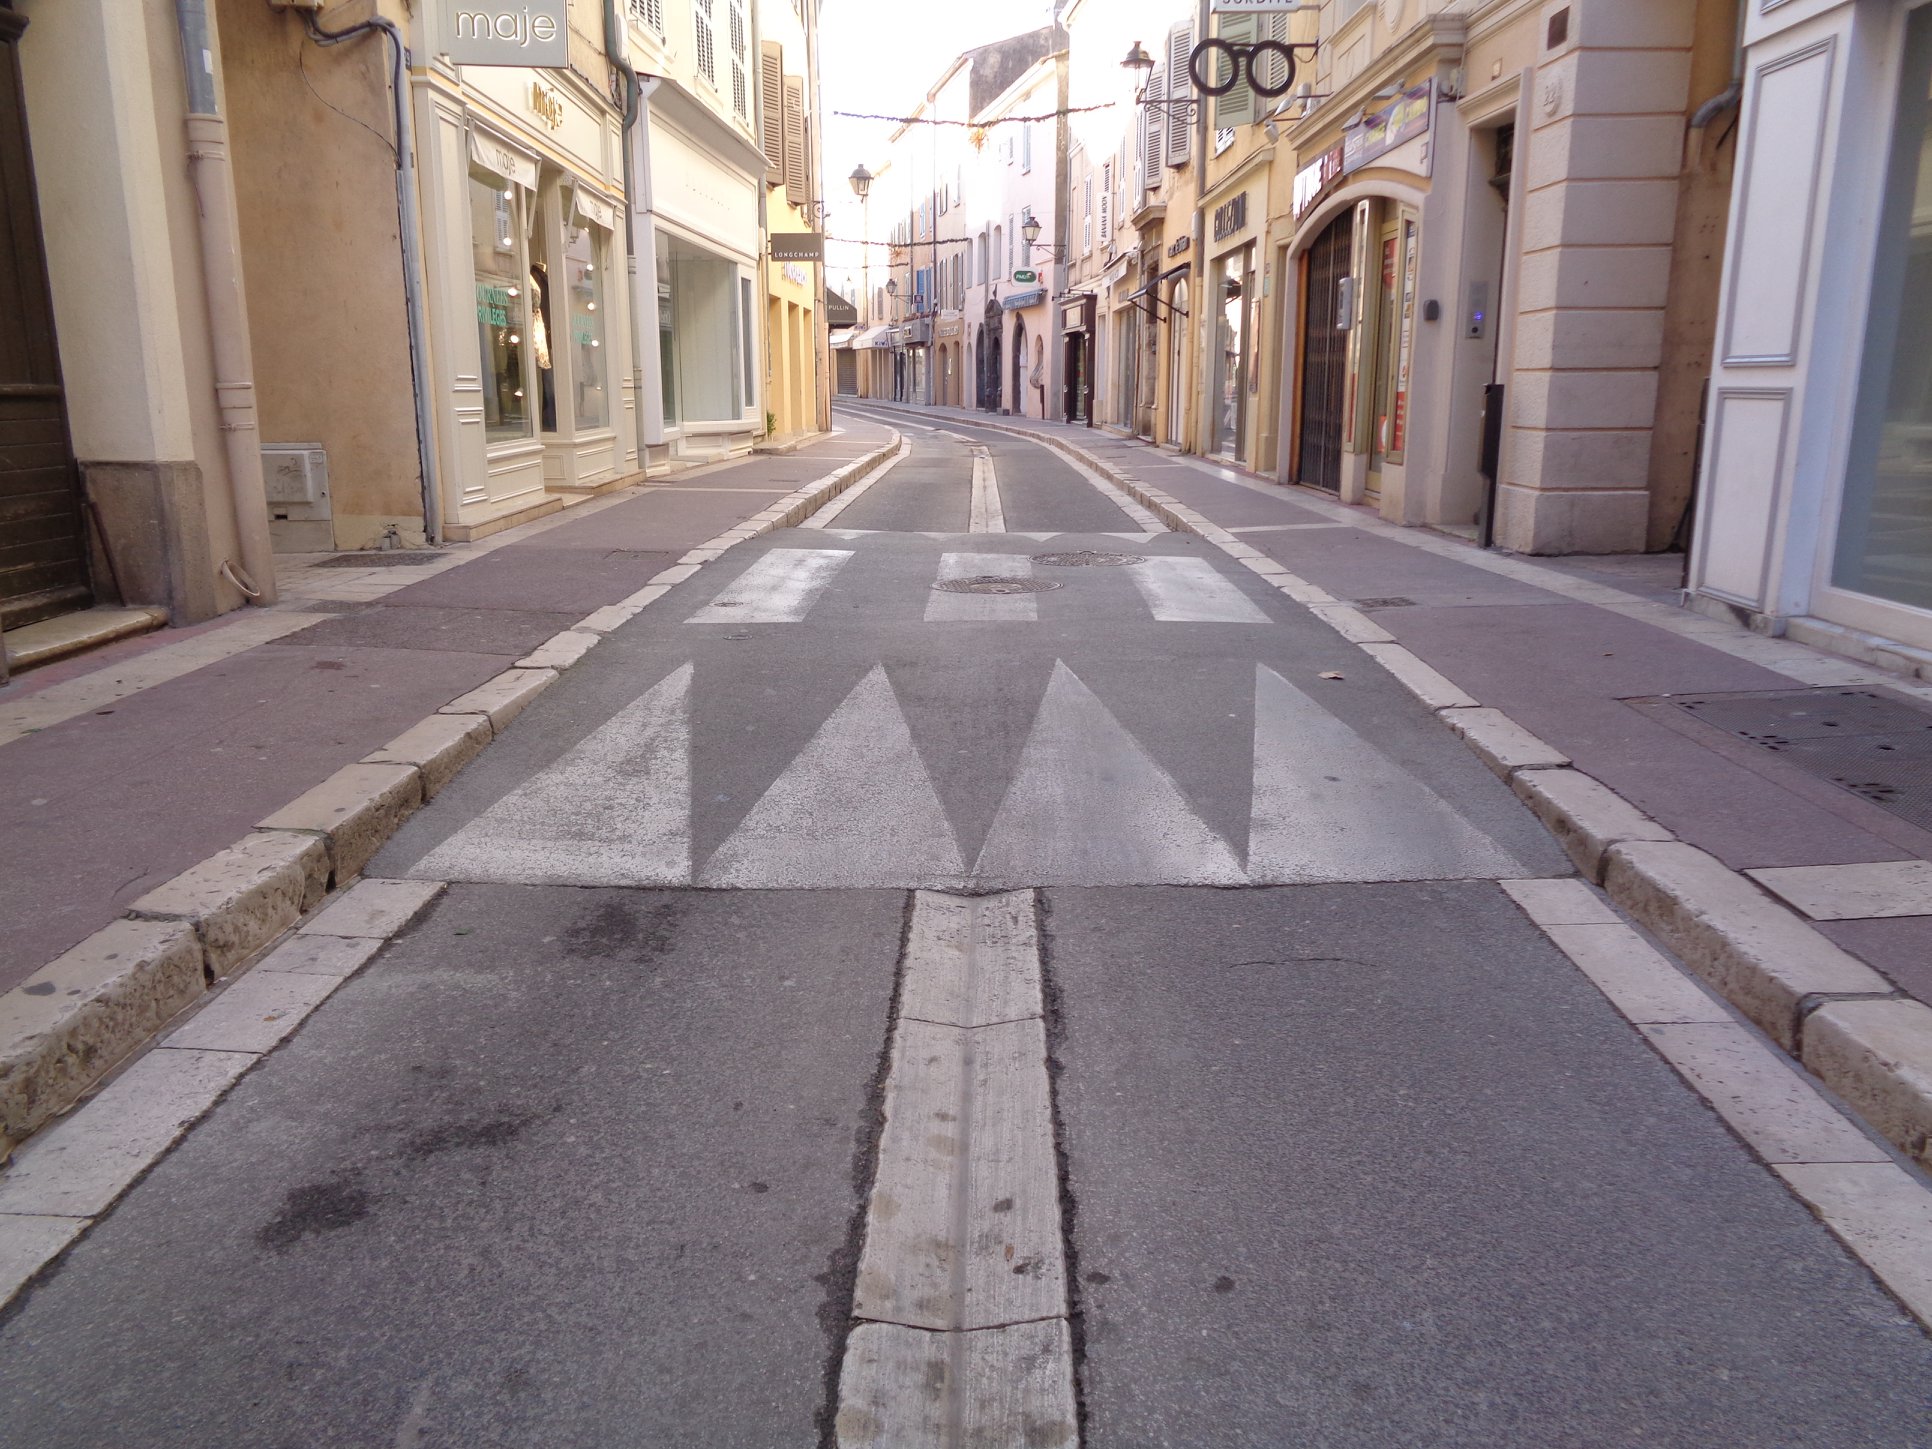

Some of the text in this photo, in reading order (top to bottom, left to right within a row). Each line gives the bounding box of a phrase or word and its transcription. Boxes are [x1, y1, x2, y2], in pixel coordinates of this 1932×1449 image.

[456, 6, 557, 48] maje
[532, 81, 563, 131] maje
[495, 149, 517, 177] maje
